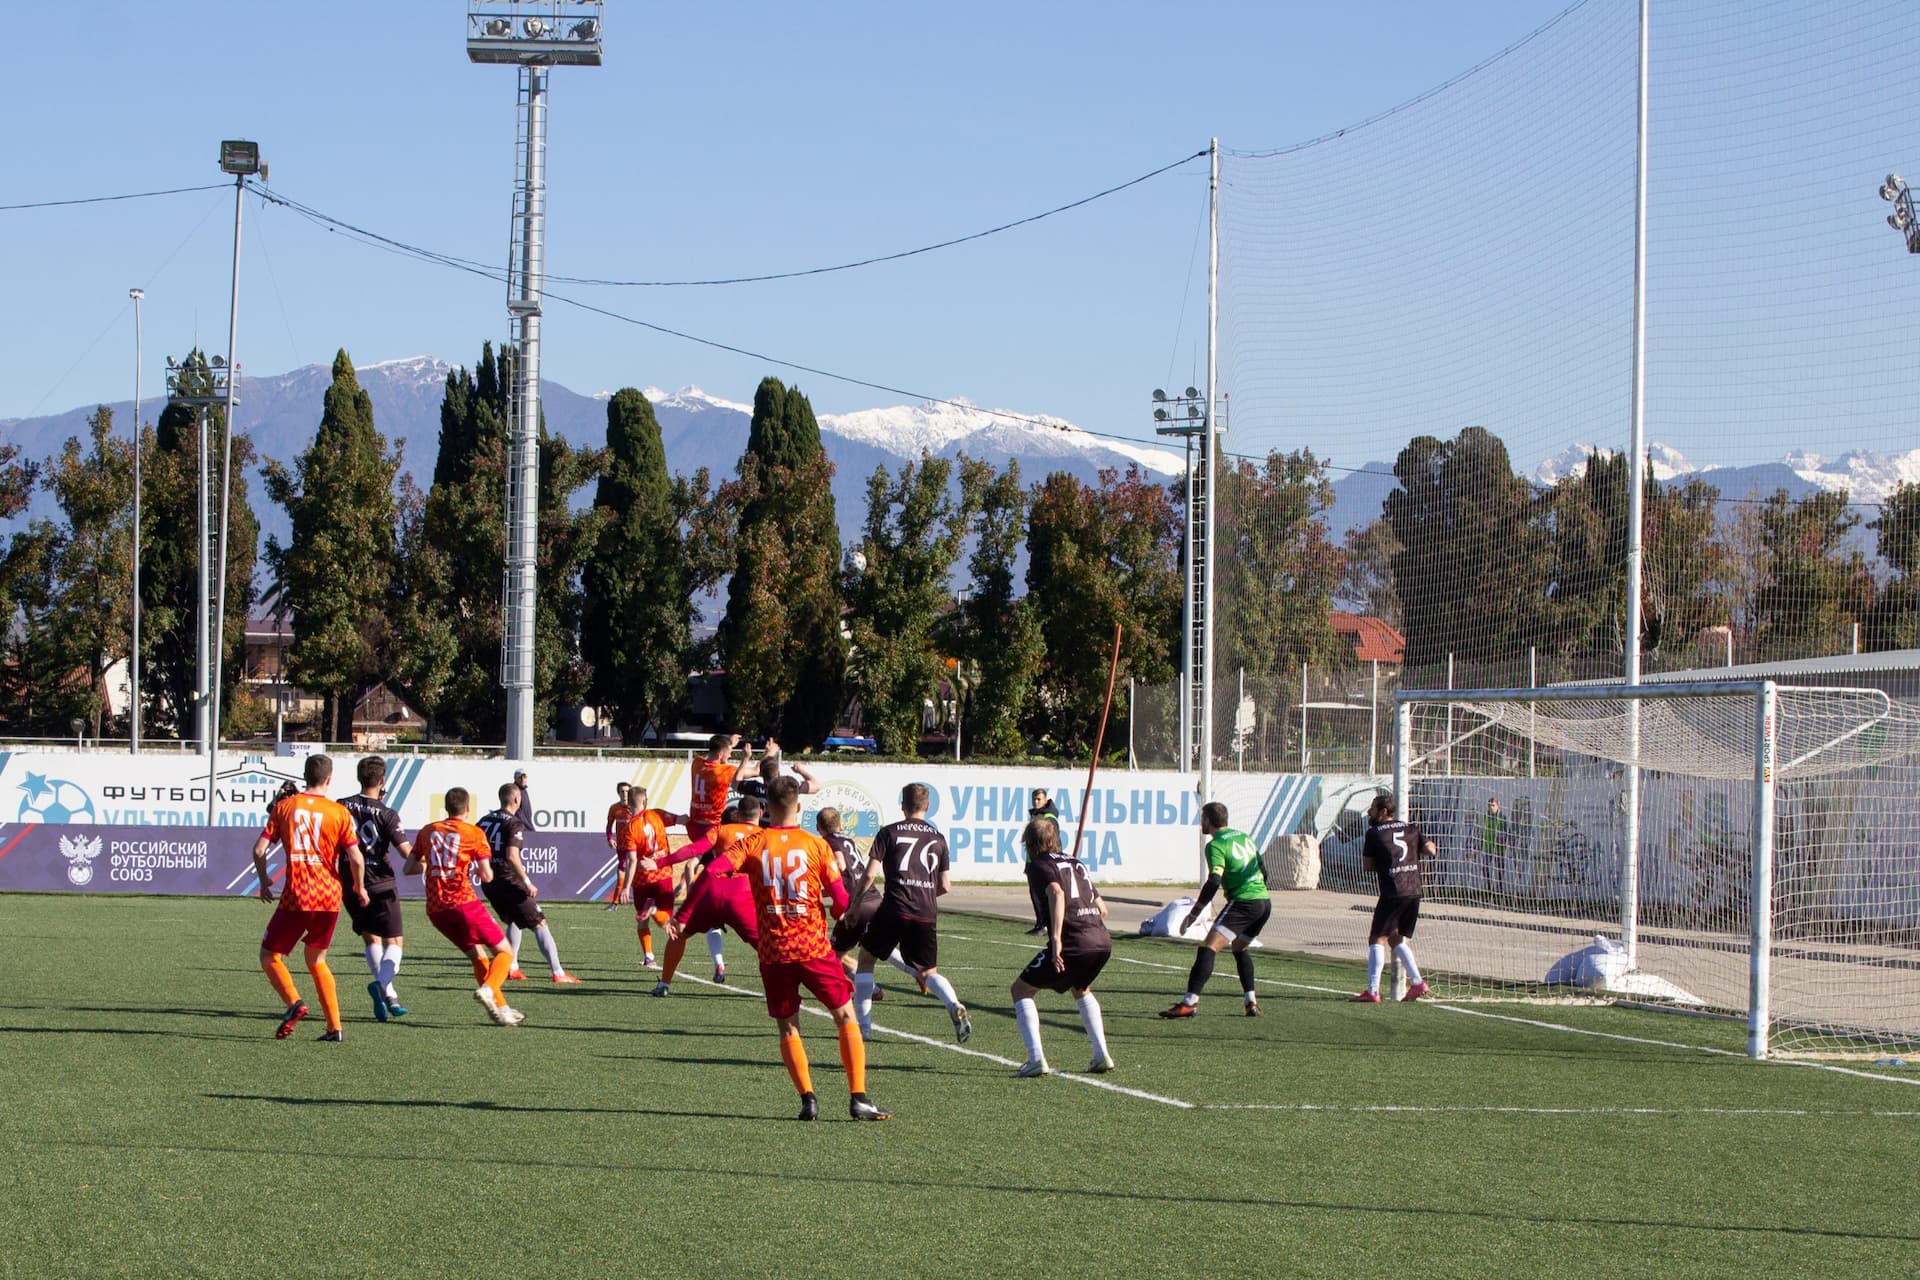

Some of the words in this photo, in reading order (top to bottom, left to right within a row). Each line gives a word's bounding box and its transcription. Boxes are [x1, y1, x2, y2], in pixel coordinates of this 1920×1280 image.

[695, 774, 706, 802] 4
[949, 786, 1216, 826] УНИАЛЬНЫХ
[110, 840, 208, 855] РОССИЙСКИЙ
[293, 808, 324, 853] 21
[1393, 830, 1409, 862] 5
[110, 855, 208, 869] ФУТБОЛЬНЫЙ
[895, 836, 939, 875] 76
[110, 868, 153, 881] СОЮЗ
[761, 848, 809, 900] 42
[1056, 861, 1095, 904] 73
